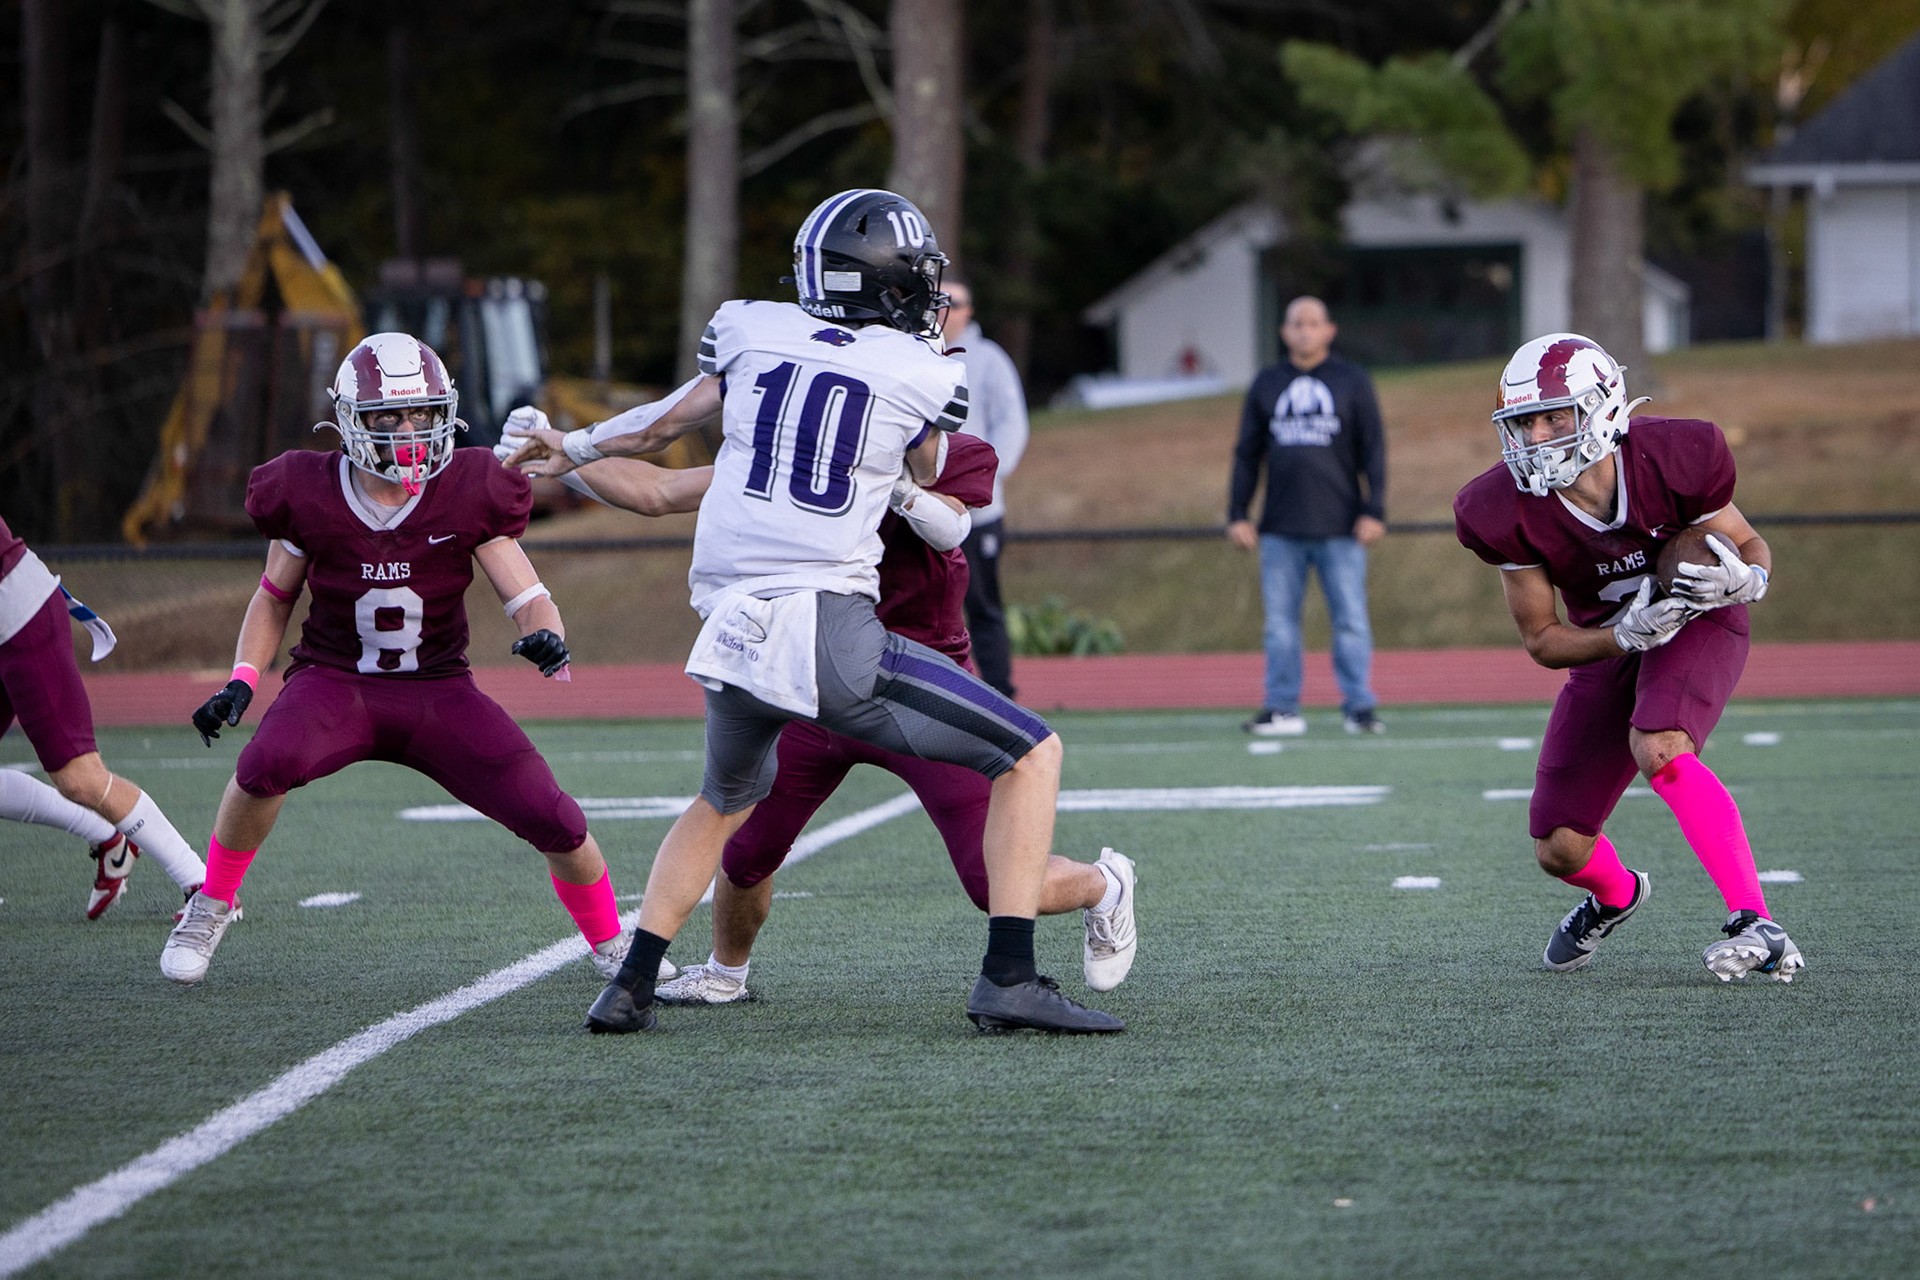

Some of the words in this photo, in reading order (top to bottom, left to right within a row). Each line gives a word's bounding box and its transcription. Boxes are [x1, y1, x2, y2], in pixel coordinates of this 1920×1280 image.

[887, 211, 925, 249] 10
[1506, 393, 1533, 406] Riddell
[743, 361, 876, 518] 10
[361, 562, 411, 581] RAMS
[1596, 550, 1646, 576] RAMS
[355, 586, 424, 674] 8
